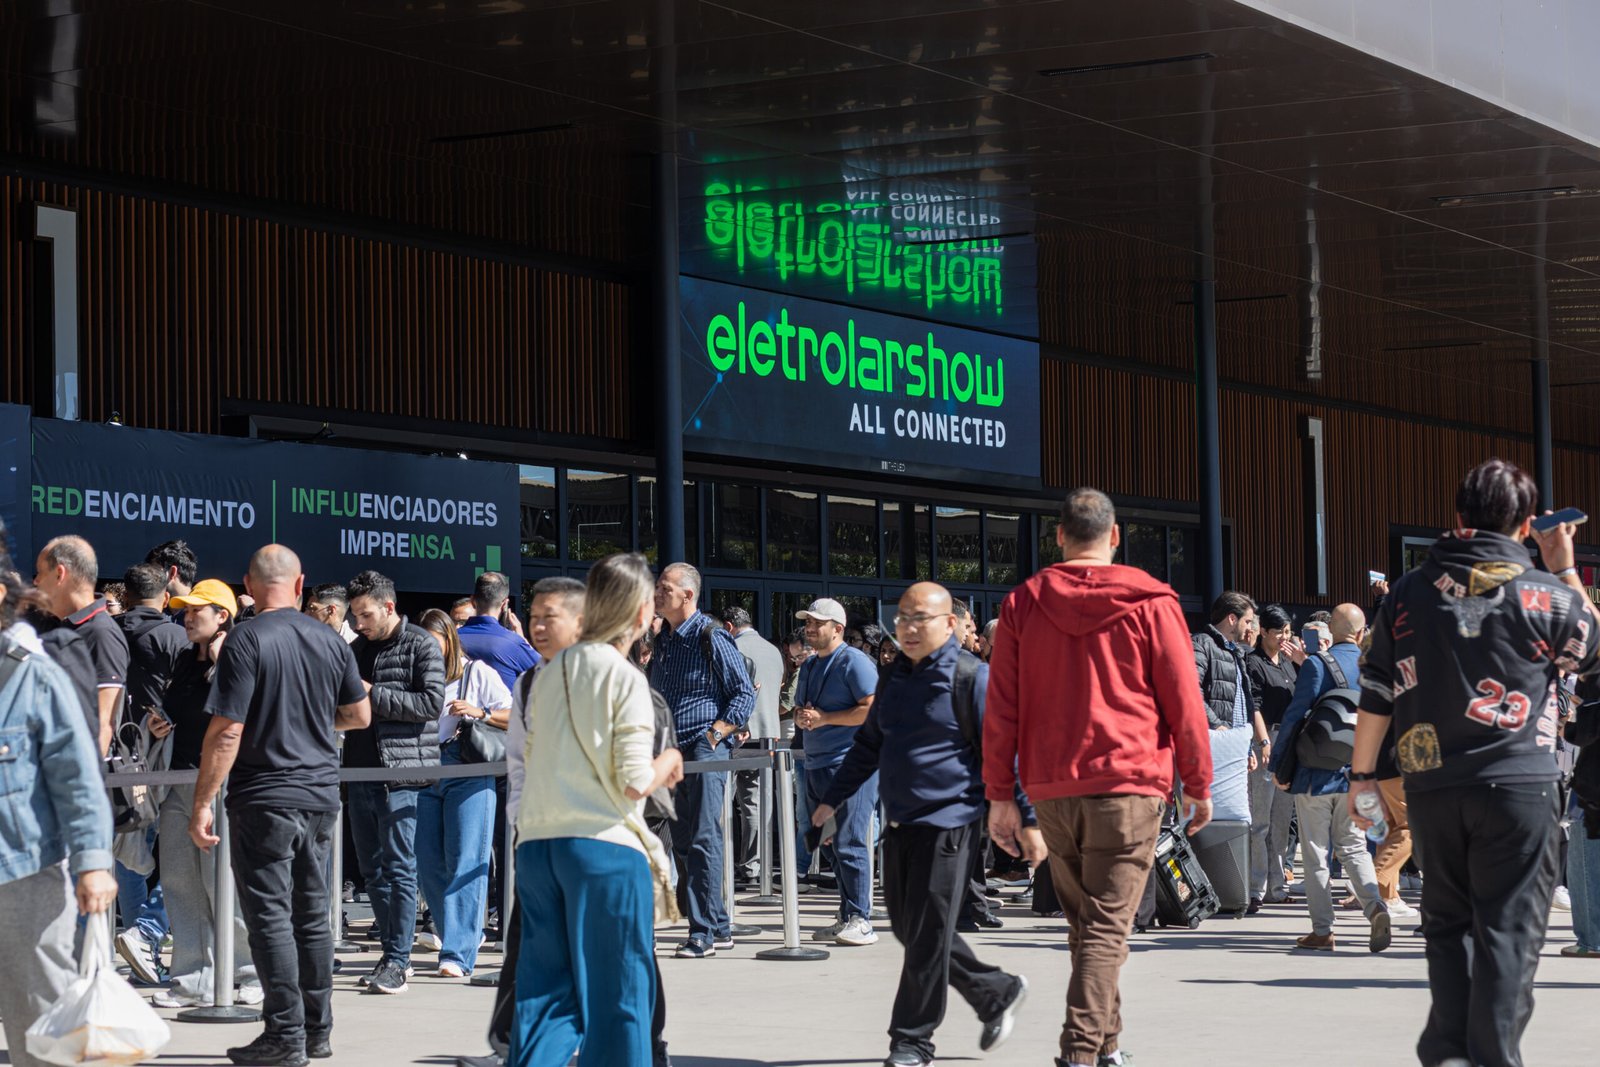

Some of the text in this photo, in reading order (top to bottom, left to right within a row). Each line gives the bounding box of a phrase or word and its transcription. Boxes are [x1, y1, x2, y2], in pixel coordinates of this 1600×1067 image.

[707, 301, 1004, 407] eletrolarshow
[849, 402, 1006, 448] ALL CONNECTED
[291, 487, 498, 527] INFLUENCIADORES
[340, 528, 455, 560] IMPRENSA
[1464, 677, 1531, 732] 23
